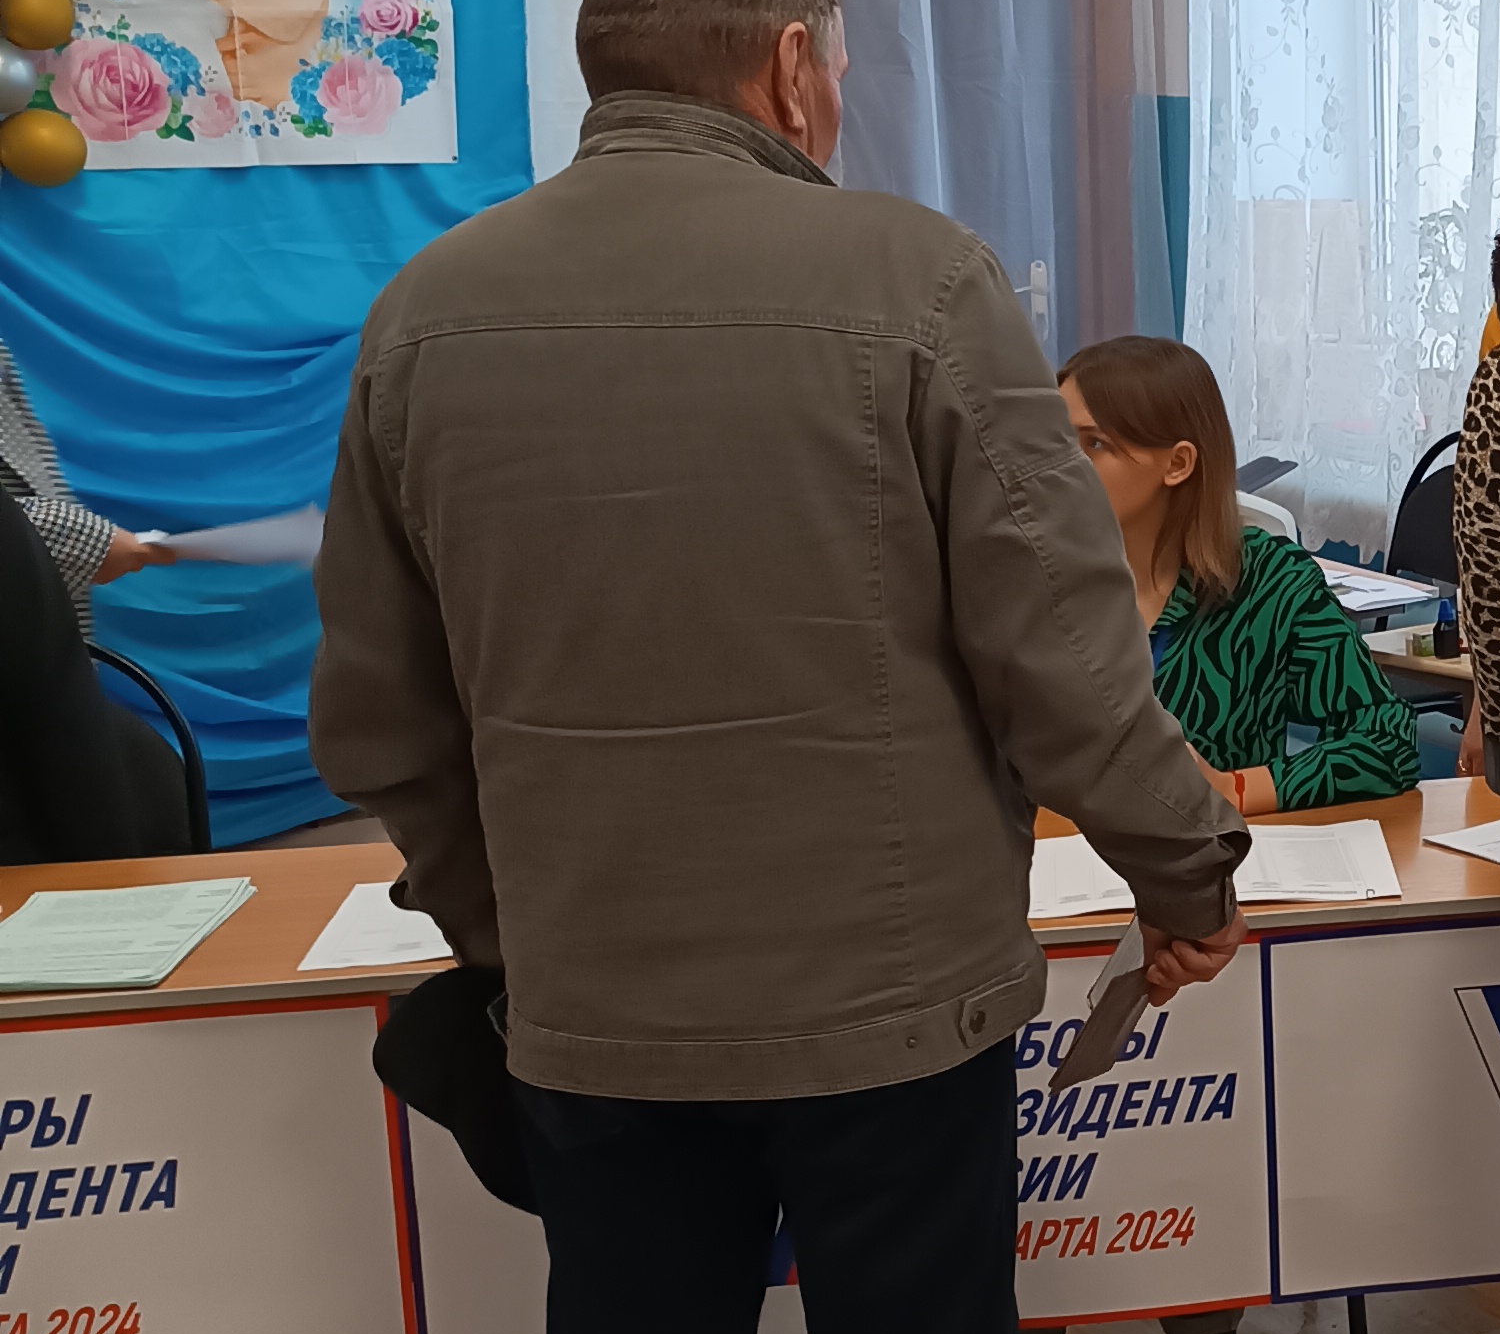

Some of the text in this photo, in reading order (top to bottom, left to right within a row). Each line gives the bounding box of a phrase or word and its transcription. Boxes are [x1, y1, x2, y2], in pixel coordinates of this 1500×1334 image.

[1017, 1072, 1238, 1142] ЗИДЕНТА
[1016, 1206, 1196, 1261] АРТА 2024
